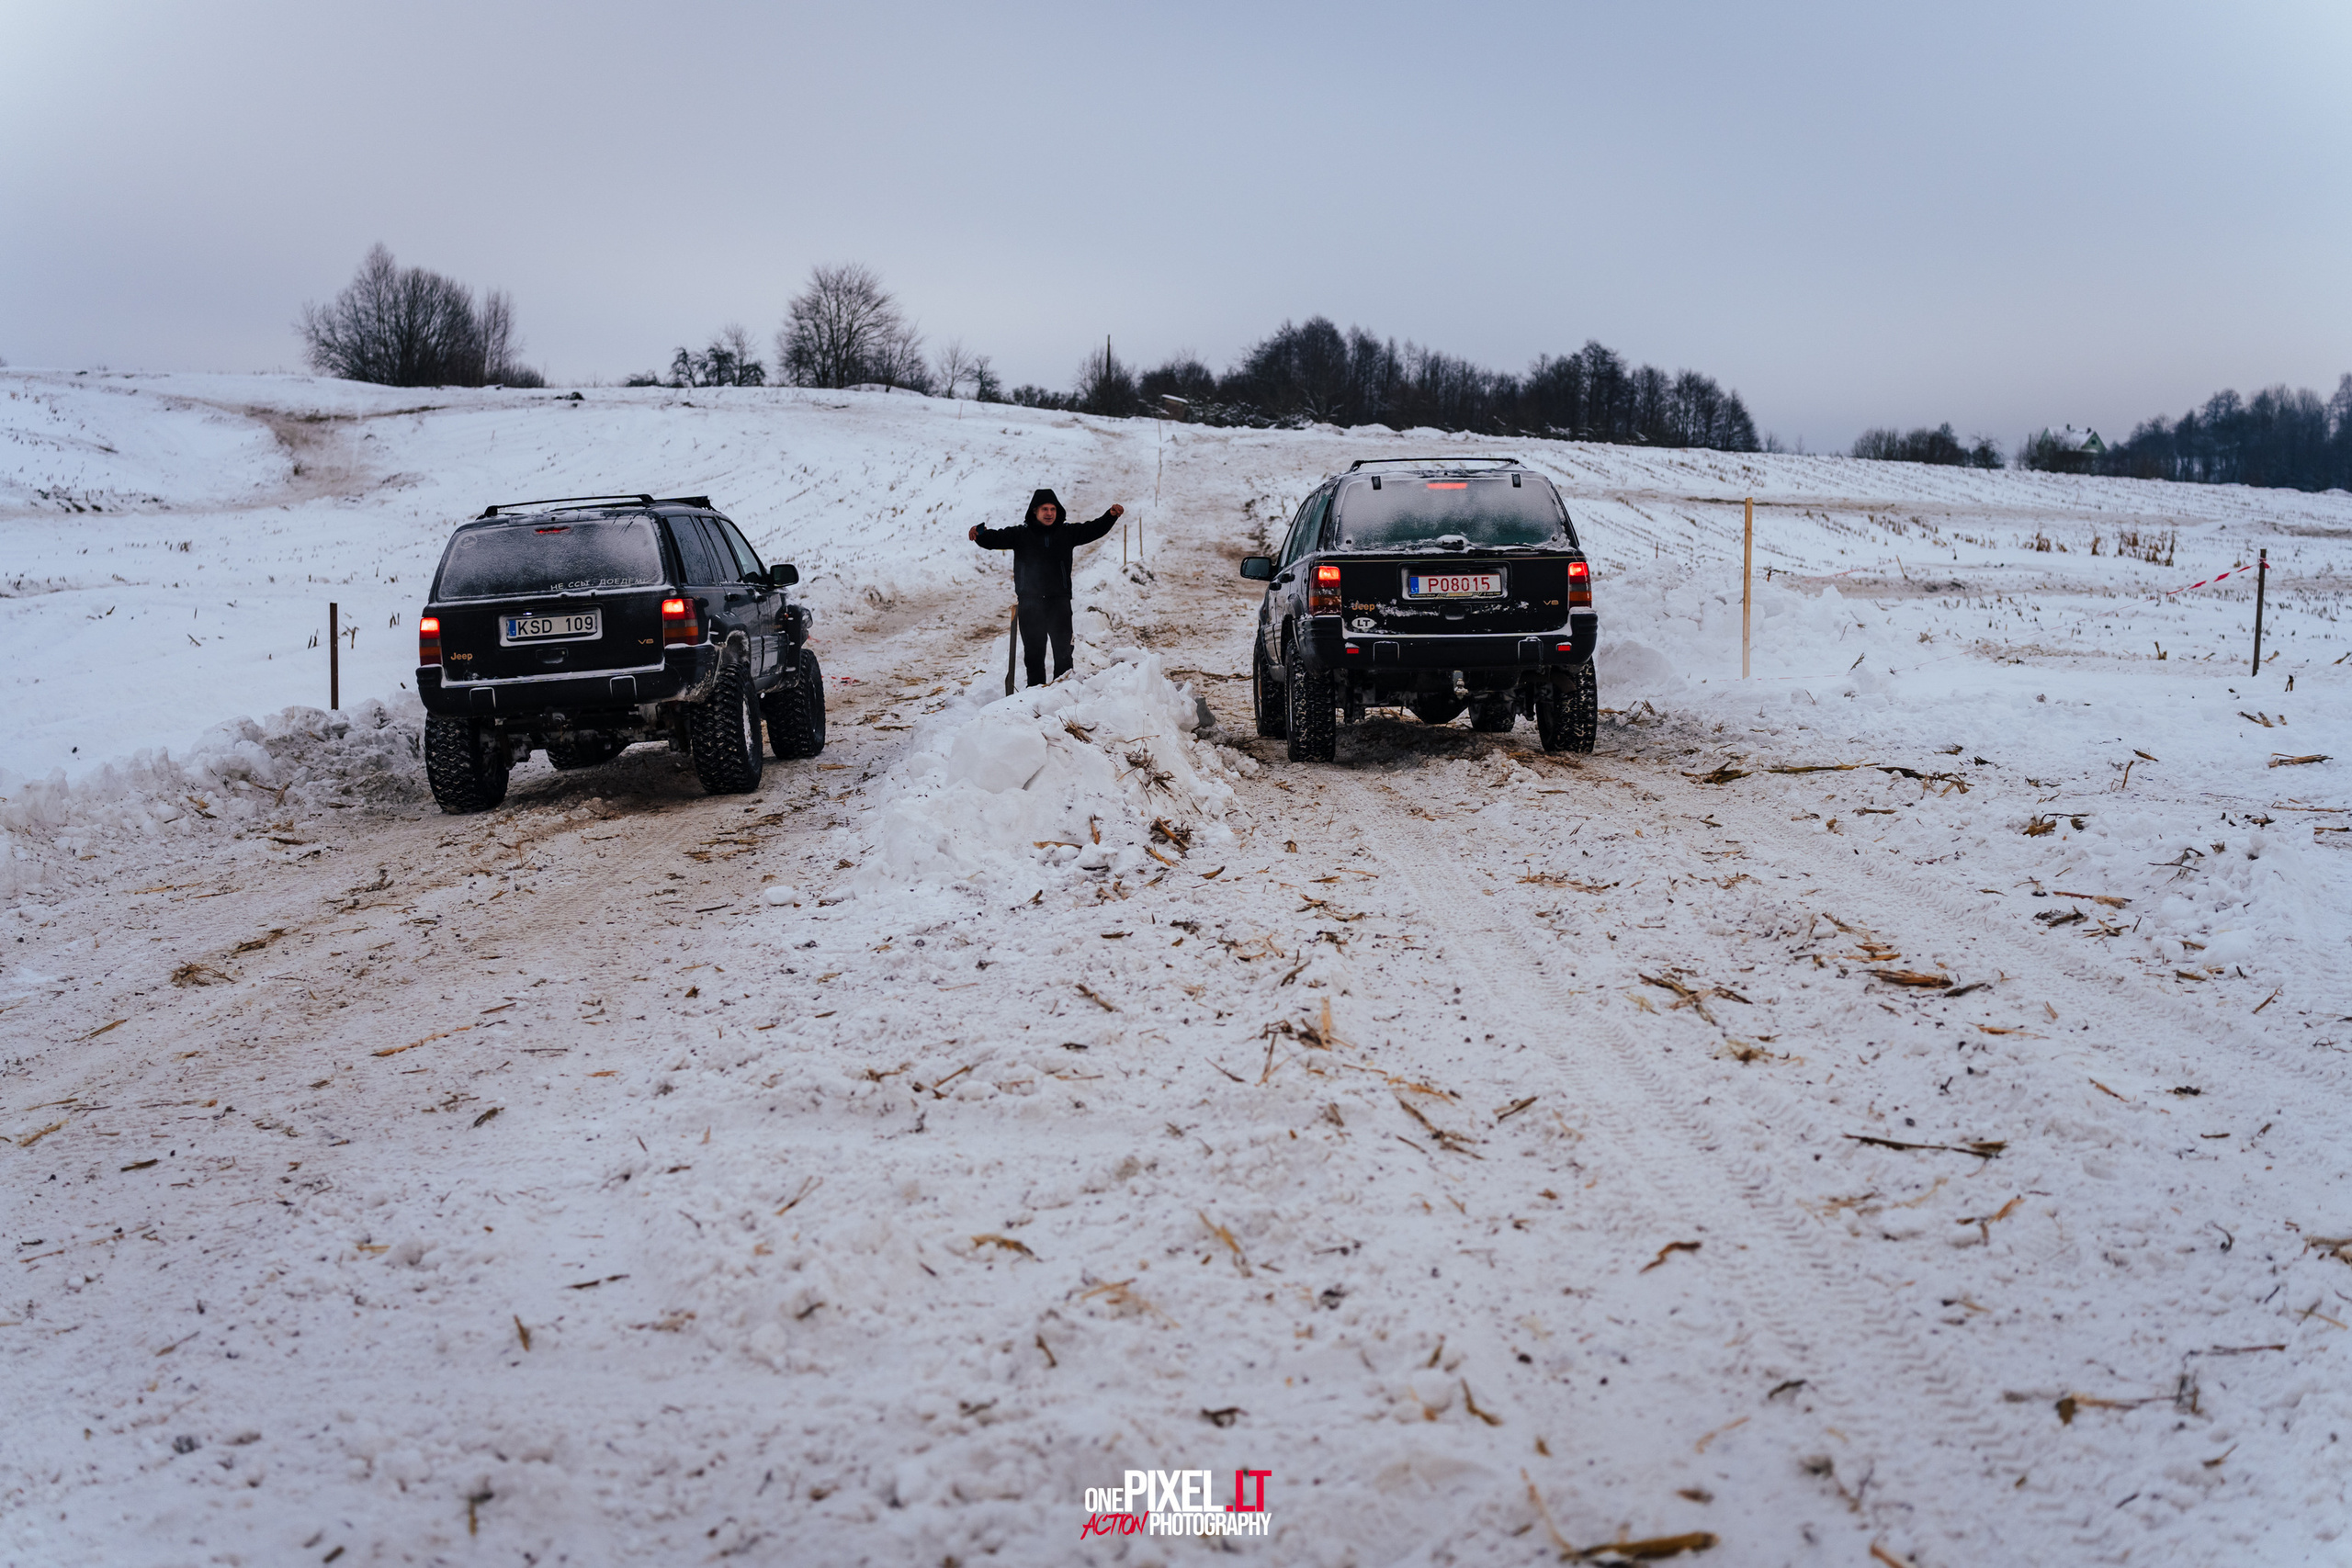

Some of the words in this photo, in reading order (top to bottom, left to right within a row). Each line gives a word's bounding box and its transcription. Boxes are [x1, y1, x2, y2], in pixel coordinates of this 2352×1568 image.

[1428, 577, 1490, 592] P08015
[1351, 601, 1375, 612] Jeep
[517, 619, 553, 635] KSD
[565, 616, 594, 632] 109
[1357, 619, 1371, 627] LT
[450, 652, 473, 660] Jeep
